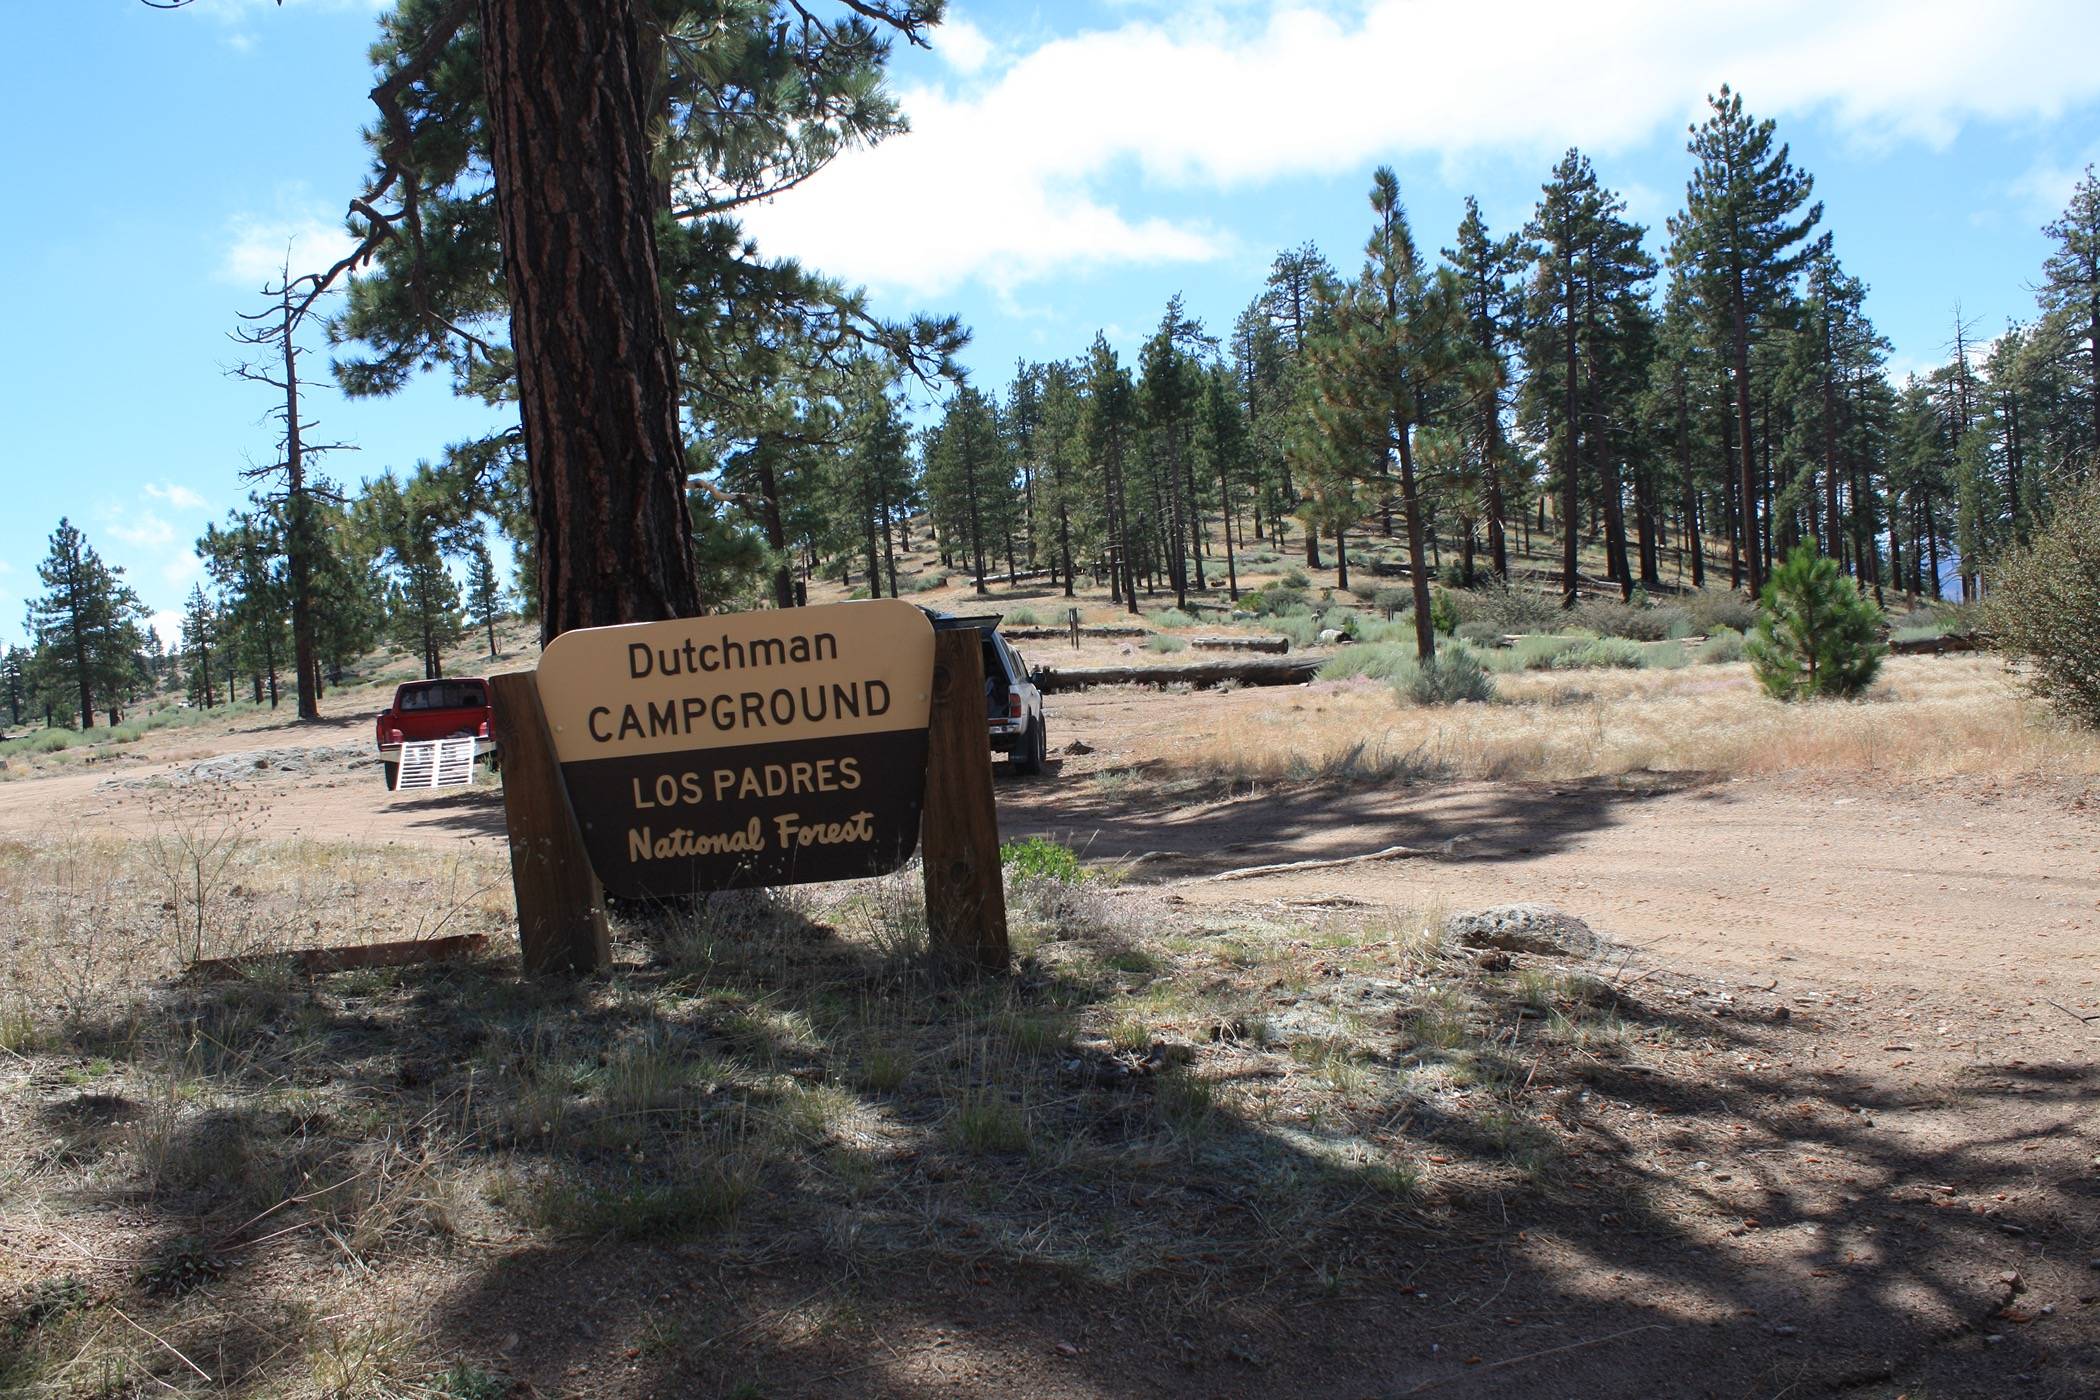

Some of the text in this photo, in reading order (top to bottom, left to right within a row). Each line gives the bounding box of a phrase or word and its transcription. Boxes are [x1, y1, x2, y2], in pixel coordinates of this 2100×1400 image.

[628, 632, 838, 679] Dutchman
[588, 680, 891, 743] CAMPGROUND
[632, 757, 862, 810] LOS PADRES
[628, 810, 874, 863] National Forest
